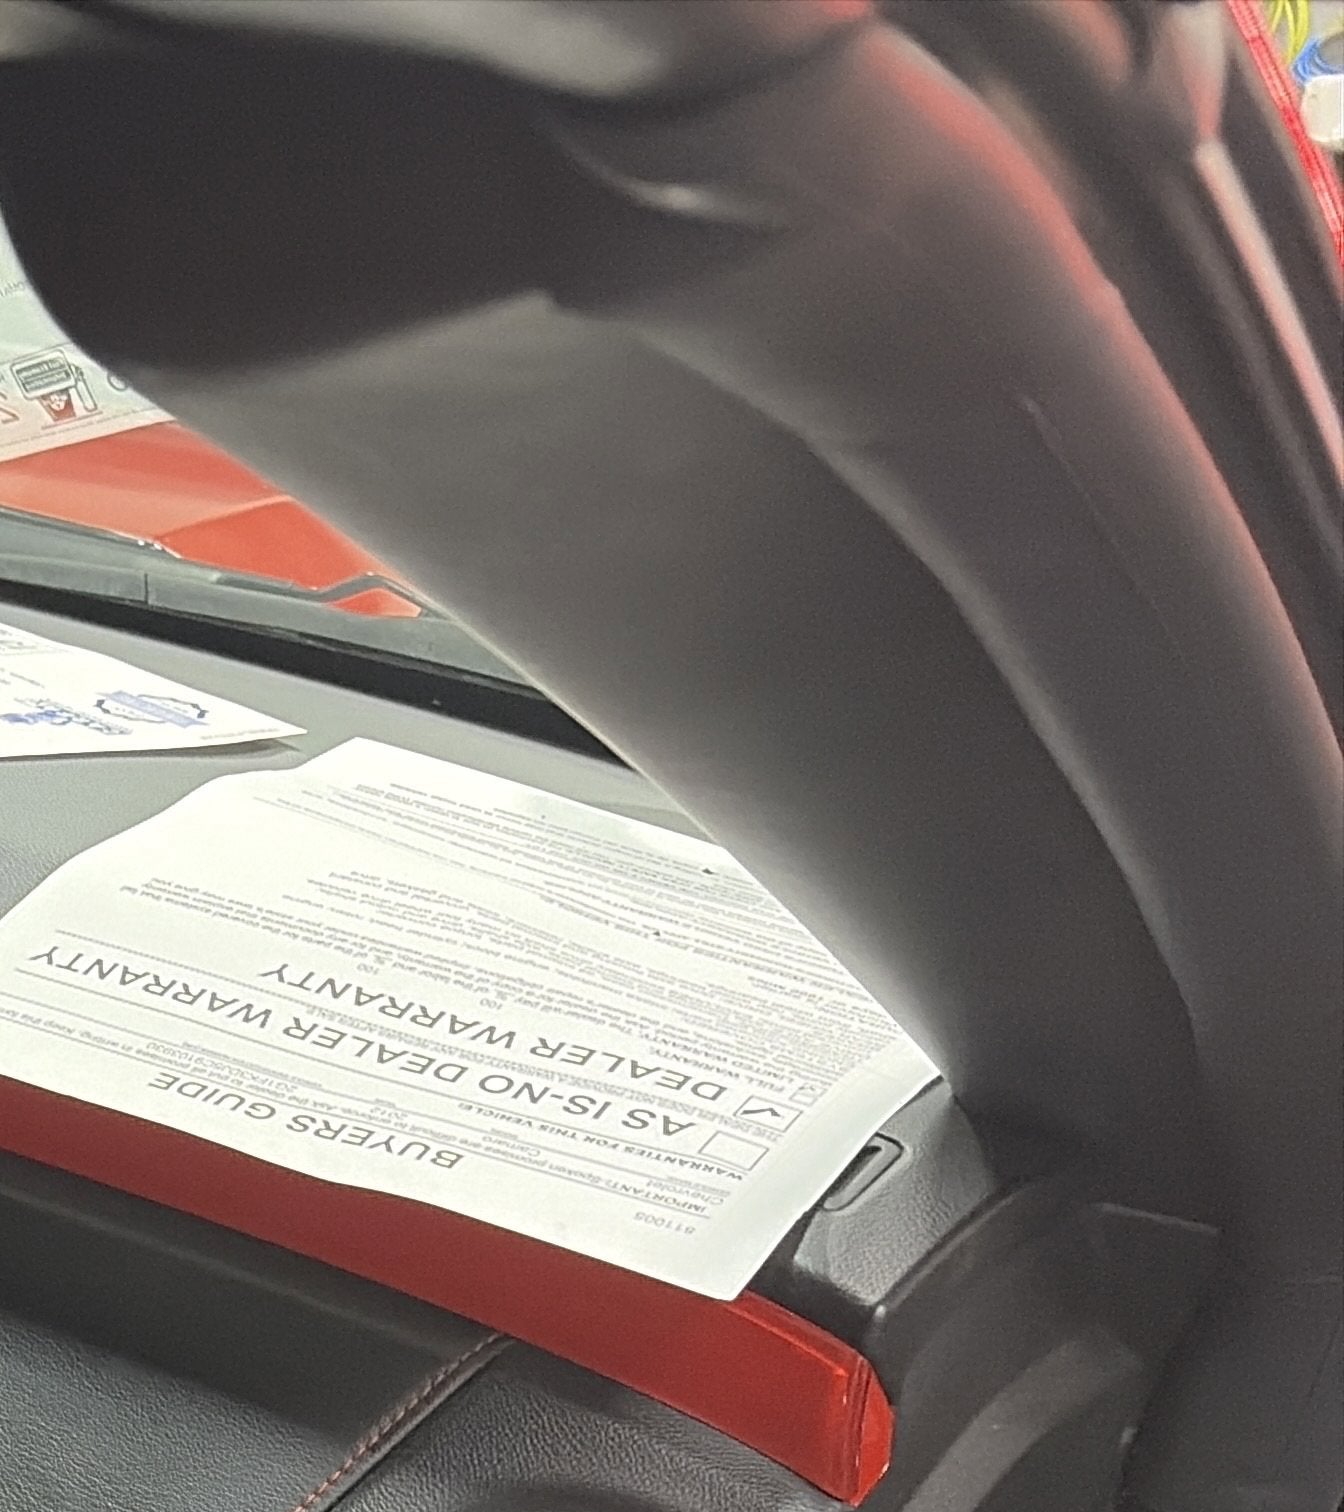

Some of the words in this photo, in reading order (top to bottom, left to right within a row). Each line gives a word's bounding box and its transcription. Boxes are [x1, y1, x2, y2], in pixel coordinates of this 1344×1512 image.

[149, 876, 176, 886] you
[172, 882, 202, 893] give
[136, 890, 165, 901] that
[139, 881, 191, 899] warranty
[199, 890, 228, 900] may
[160, 896, 213, 914] systems
[190, 895, 235, 911] explain
[209, 910, 261, 927] covered
[232, 908, 259, 919] that
[258, 915, 326, 937] documents
[295, 916, 324, 927] your
[258, 924, 283, 934] the
[279, 930, 301, 939] for
[323, 925, 360, 938] under
[298, 935, 334, 949] parts
[323, 933, 351, 944] any
[347, 940, 368, 949] for
[330, 945, 354, 955] the
[367, 946, 393, 956] and
[353, 962, 381, 975] 100
[389, 961, 418, 973] and
[415, 969, 451, 983] labor
[451, 969, 475, 980] the
[26, 942, 281, 1028] WARRANTY
[449, 978, 475, 990] the
[490, 980, 525, 993] copy
[257, 960, 522, 1048] WARRANTY
[477, 997, 504, 1010] 100
[512, 996, 541, 1008] pay
[539, 1004, 564, 1015] will
[15, 1013, 44, 1025] this
[562, 1010, 606, 1026] dealer
[39, 1019, 78, 1035] Keep
[606, 1022, 636, 1034] The
[277, 1016, 470, 1083] DEALER
[131, 1048, 192, 1070] promises
[187, 1066, 208, 1075] all
[205, 1070, 231, 1081] put
[525, 1037, 727, 1102] DEALER
[729, 1059, 795, 1084] LIMITED
[227, 1077, 245, 1086] to
[741, 1075, 785, 1093] FULL
[145, 1071, 281, 1122] GUIDE
[242, 1082, 287, 1099] dealer
[473, 1069, 612, 1119] IS-NO
[284, 1094, 309, 1105] the
[309, 1100, 338, 1112] Ask
[368, 1105, 409, 1121] 2012
[617, 1105, 697, 1139] AS
[536, 1123, 581, 1140] THIS
[282, 1112, 464, 1169] BUYERS
[457, 1138, 482, 1149] are
[480, 1134, 543, 1157] Camaro
[580, 1134, 620, 1150] FOR
[484, 1145, 547, 1168] promises
[620, 1145, 744, 1181] WARRANTIES
[643, 1178, 726, 1207] Chevrolet
